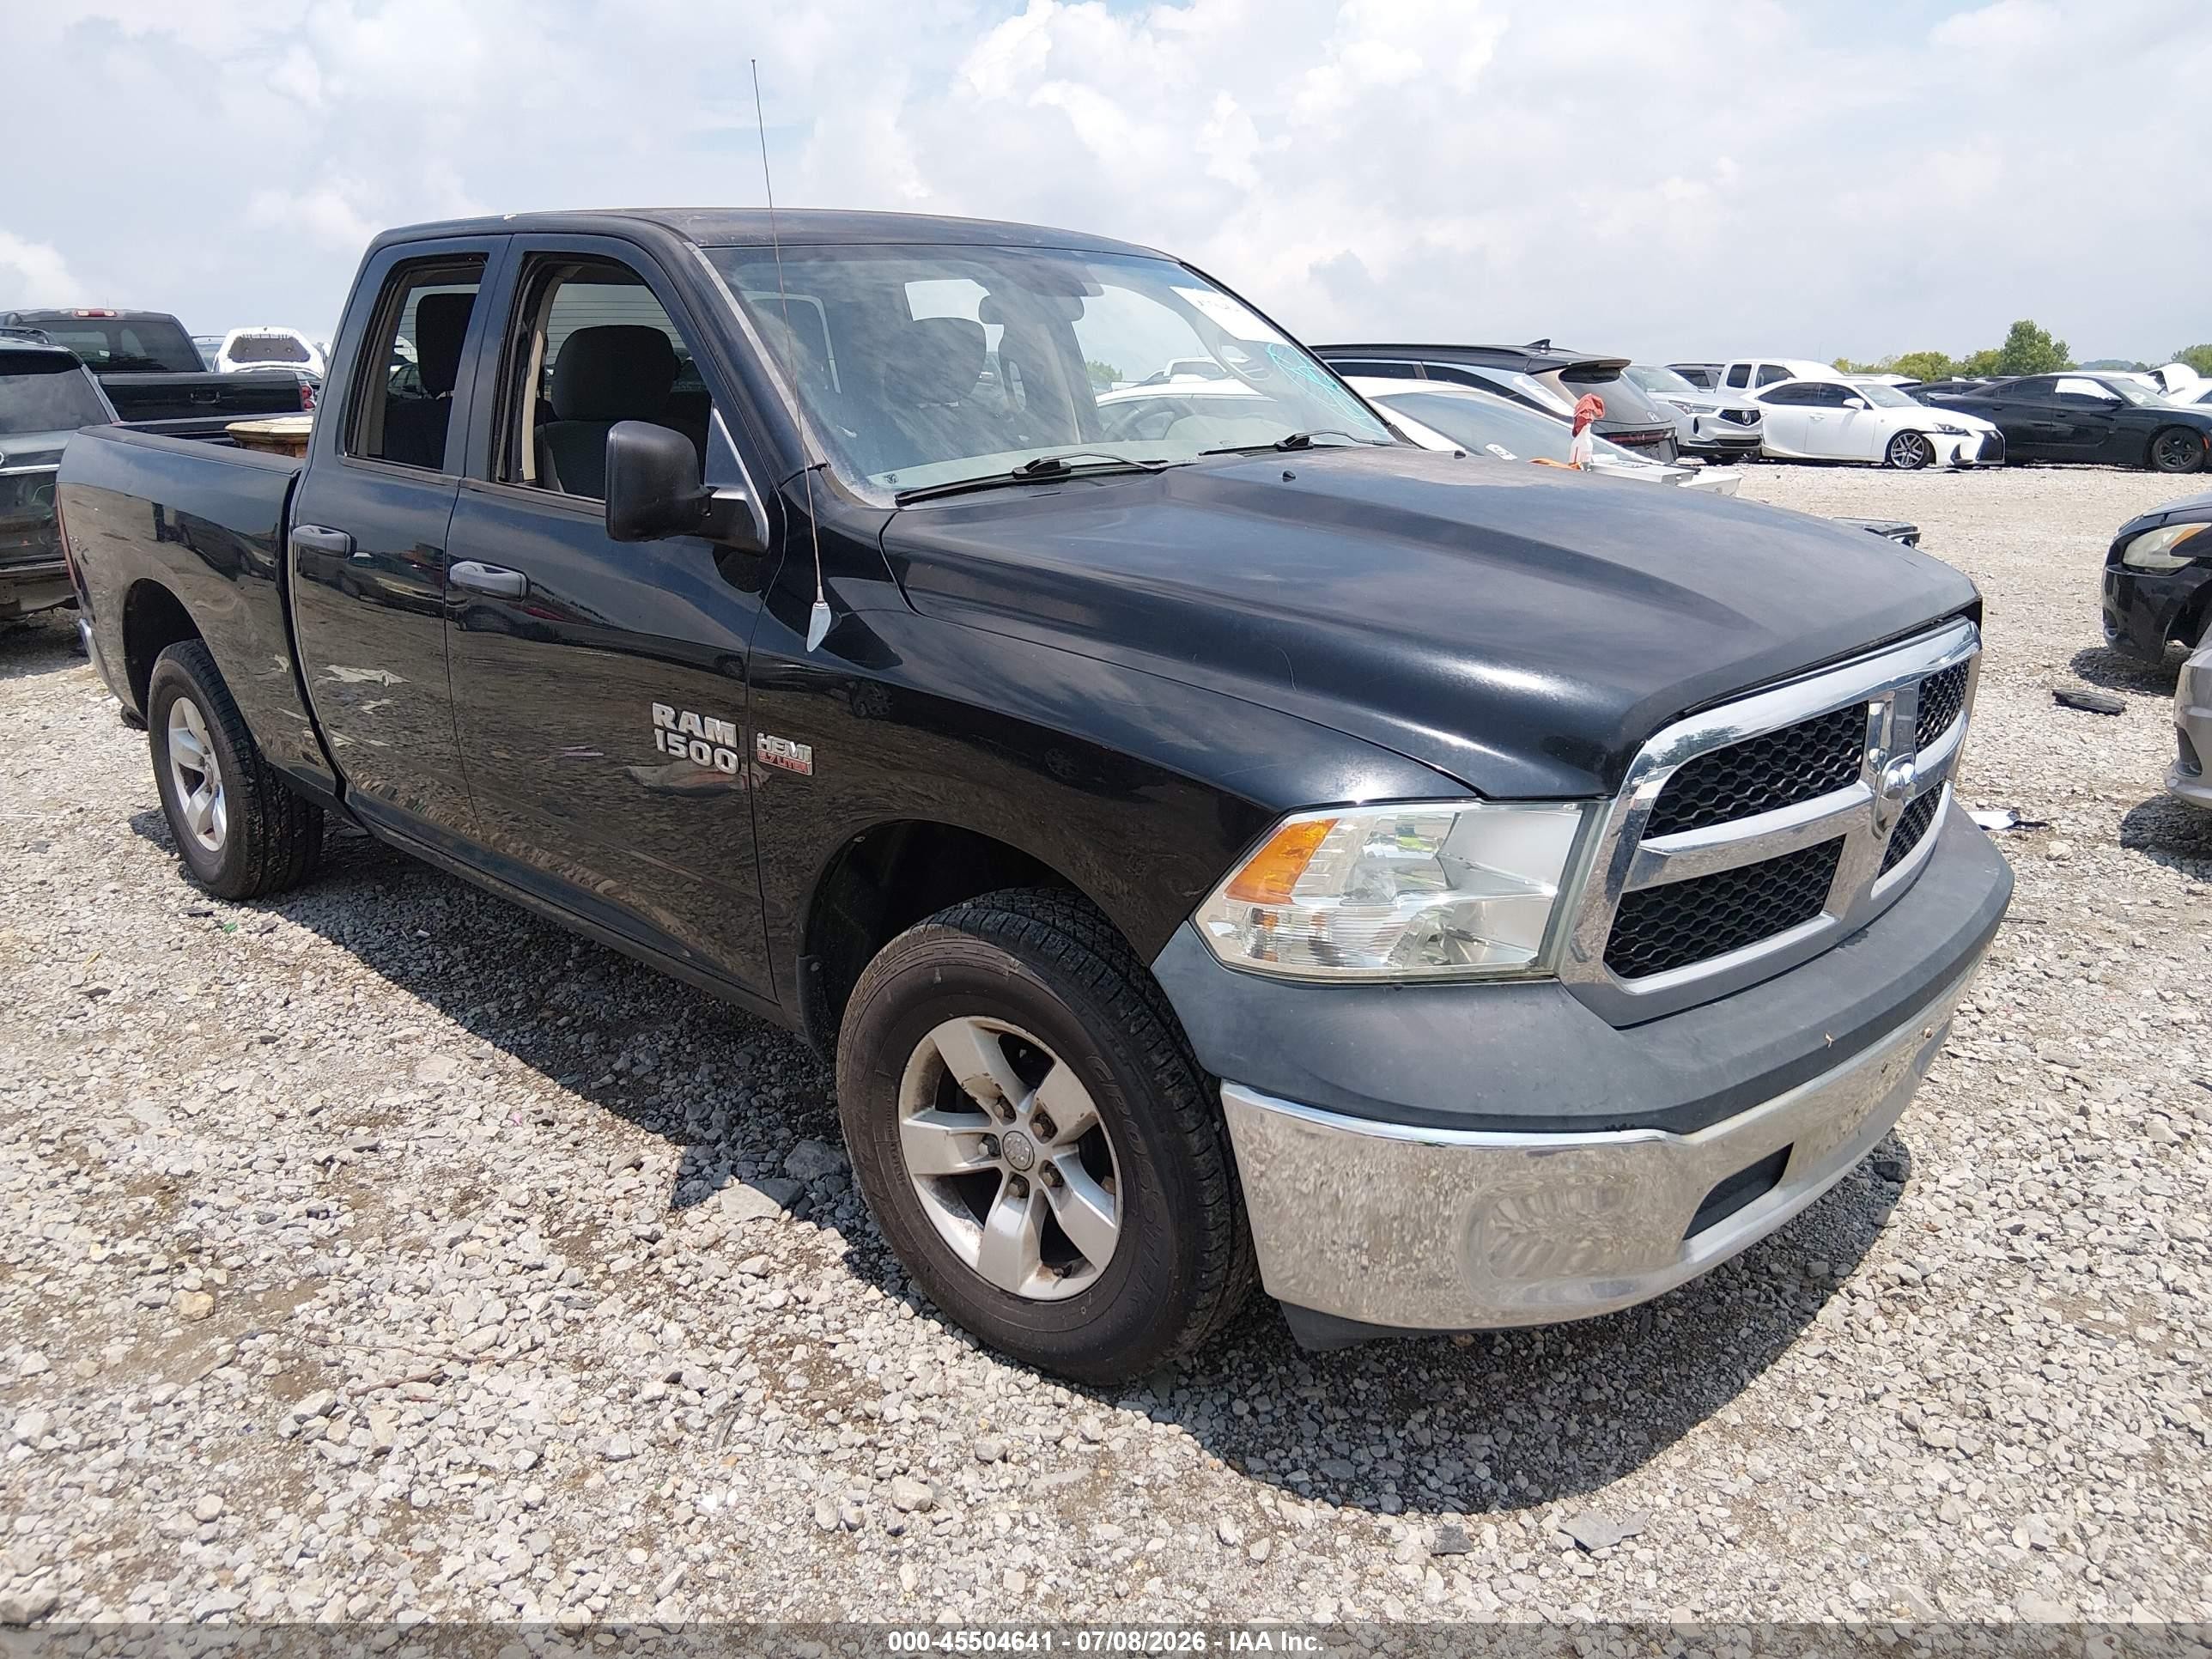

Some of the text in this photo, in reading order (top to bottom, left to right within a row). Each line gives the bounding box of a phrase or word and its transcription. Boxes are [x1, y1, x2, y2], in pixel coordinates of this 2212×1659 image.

[652, 702, 738, 748] RAM
[757, 732, 812, 763] HEMI
[654, 728, 739, 775] 1500
